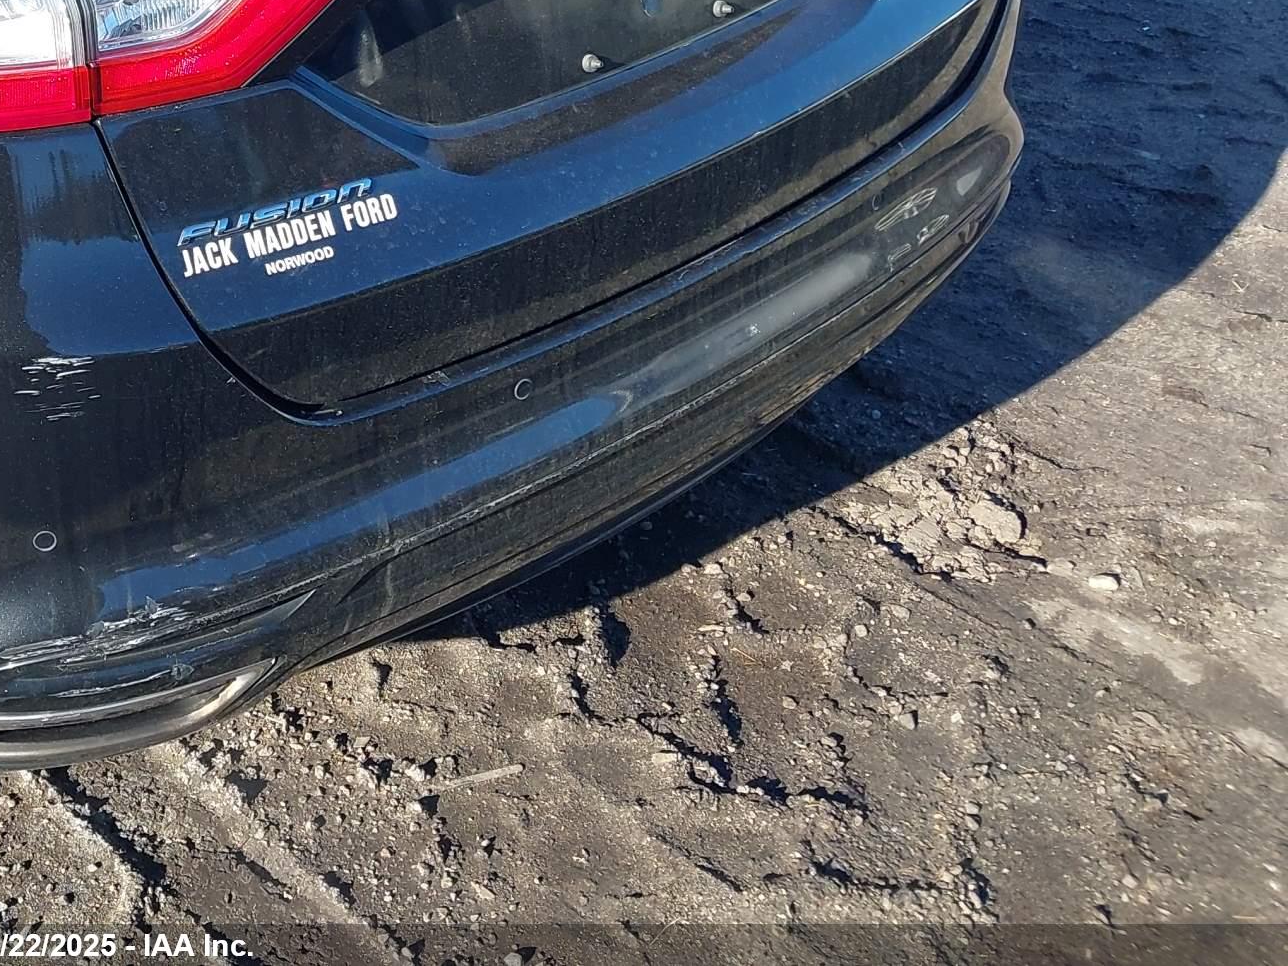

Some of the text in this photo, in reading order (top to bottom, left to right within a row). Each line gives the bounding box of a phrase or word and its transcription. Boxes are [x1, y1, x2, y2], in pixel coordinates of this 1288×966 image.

[182, 193, 398, 278] JACK MADDEN FORD
[265, 245, 334, 276] NORWOOD
